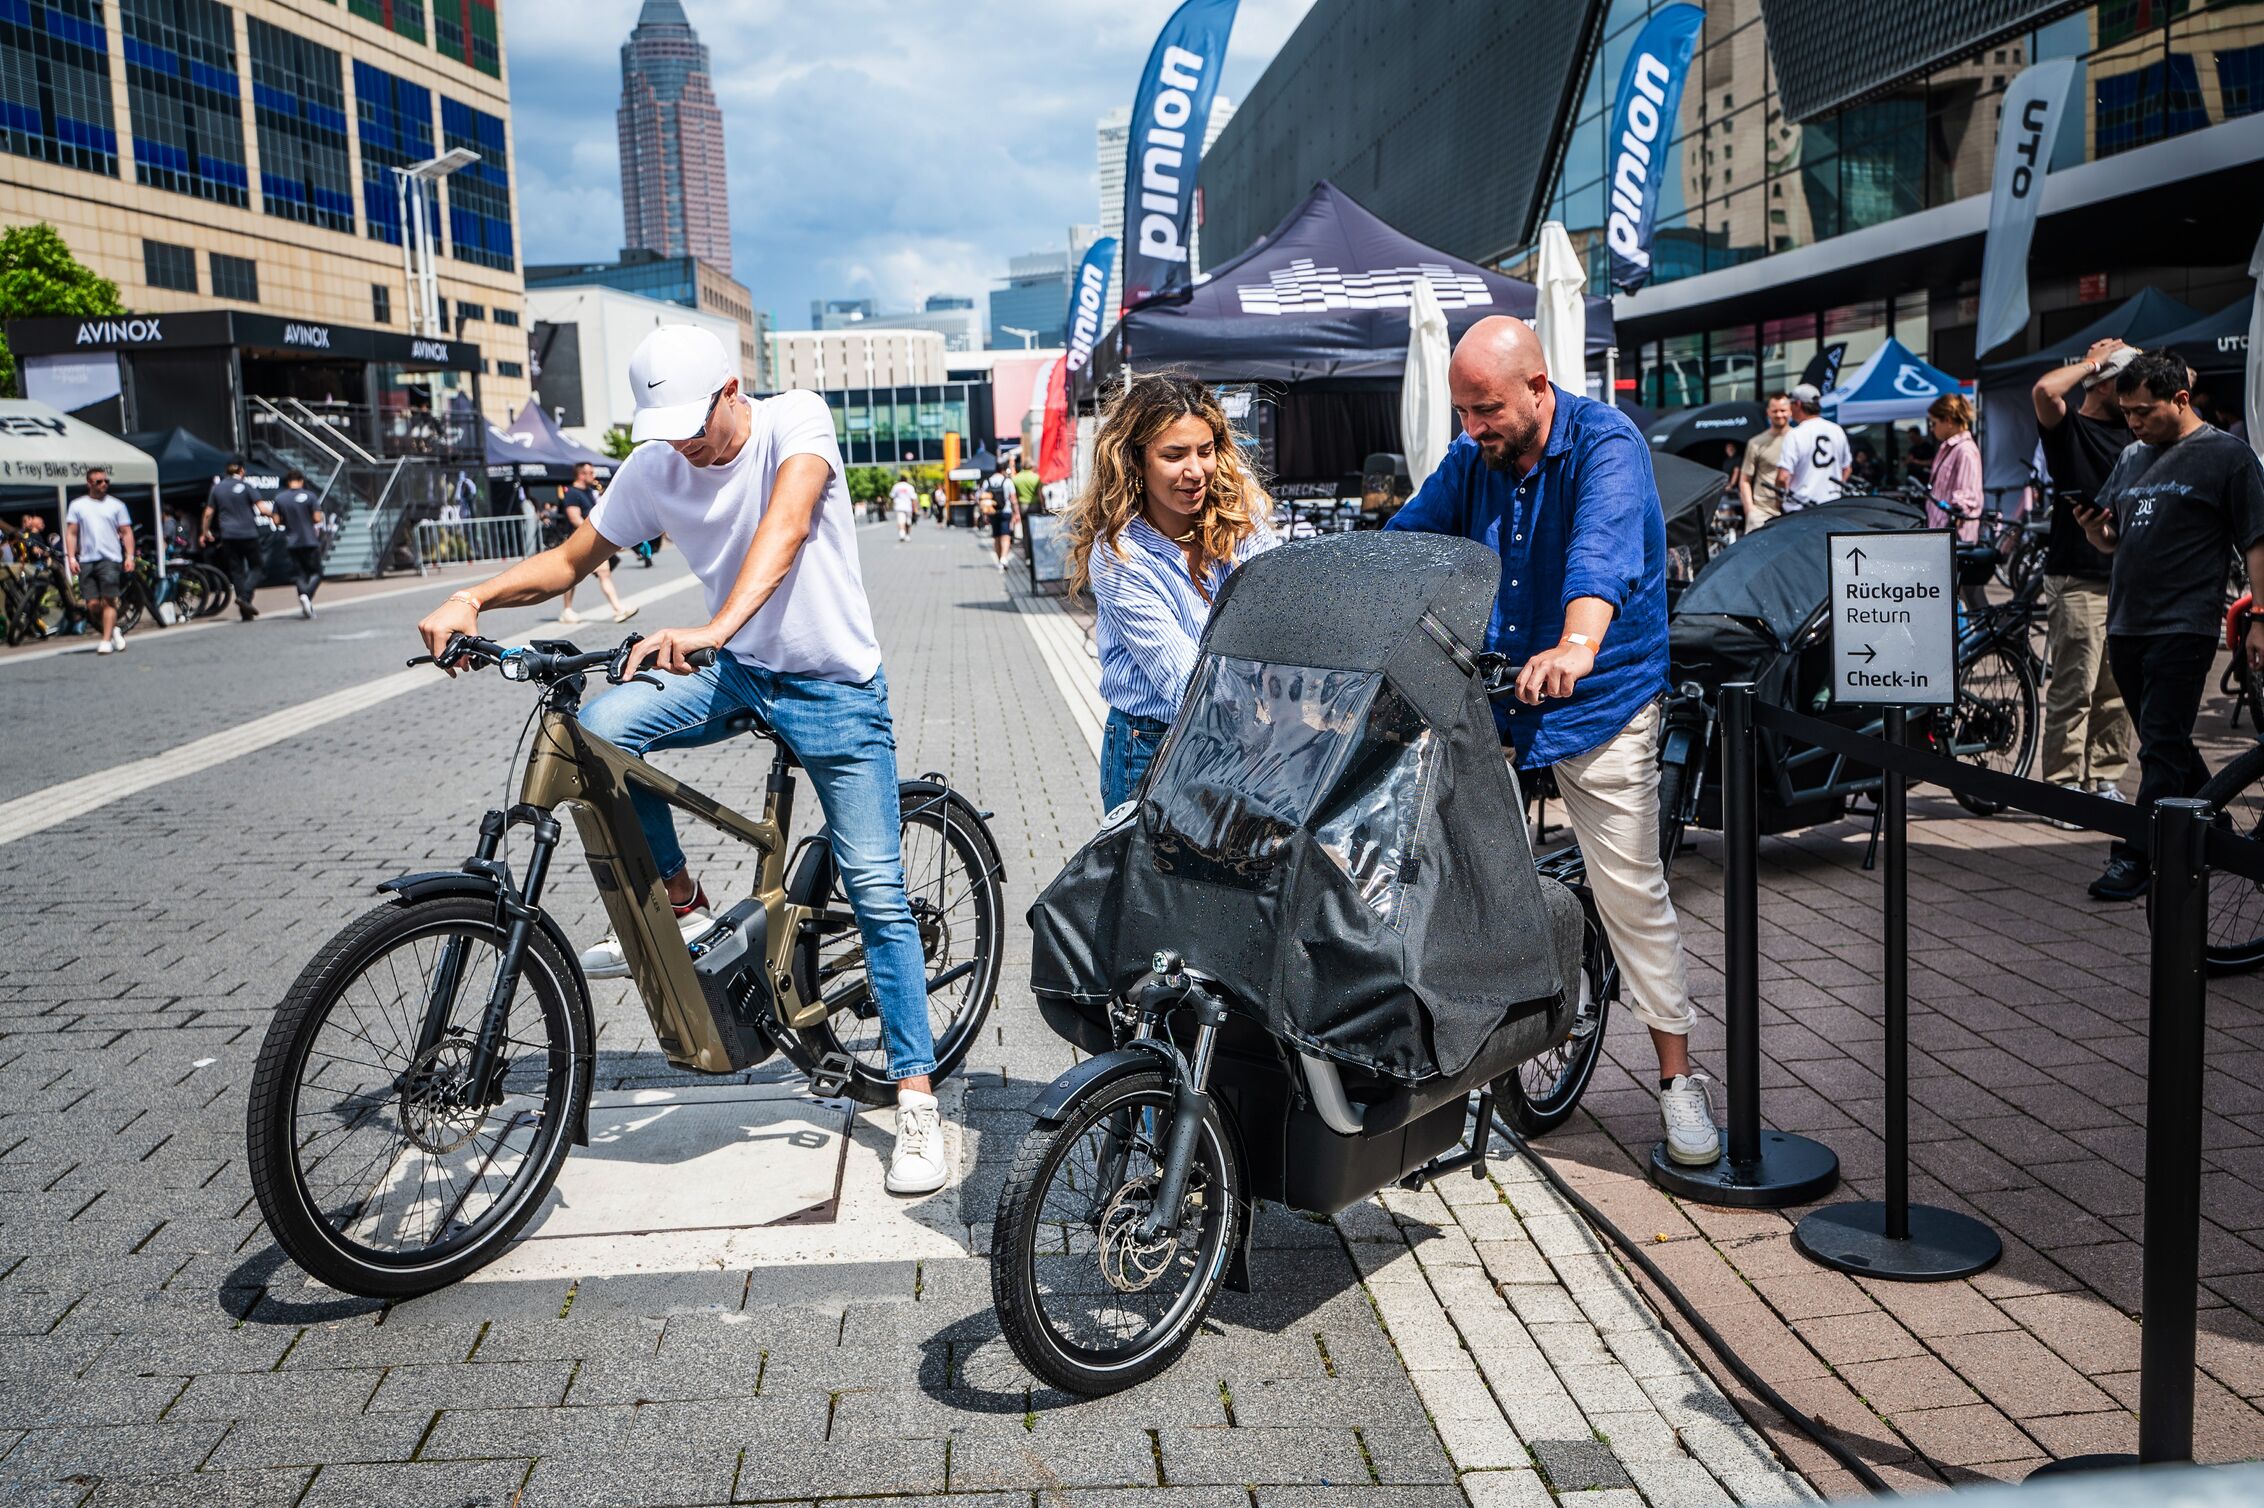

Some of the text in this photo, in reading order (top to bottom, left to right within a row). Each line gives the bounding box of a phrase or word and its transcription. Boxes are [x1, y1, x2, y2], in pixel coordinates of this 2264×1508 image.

[1139, 45, 1204, 262] pinion
[1608, 52, 1670, 268] pinion
[2012, 99, 2048, 199] UTO
[76, 318, 163, 345] AVINOX
[284, 323, 330, 348] AVINOX
[411, 340, 448, 362] AVINOX
[17, 461, 42, 479] Frey
[45, 462, 69, 478] Bike
[1846, 582, 1940, 602] Rückgabe
[1847, 608, 1910, 623] Return
[1847, 670, 1928, 687] Check-in
